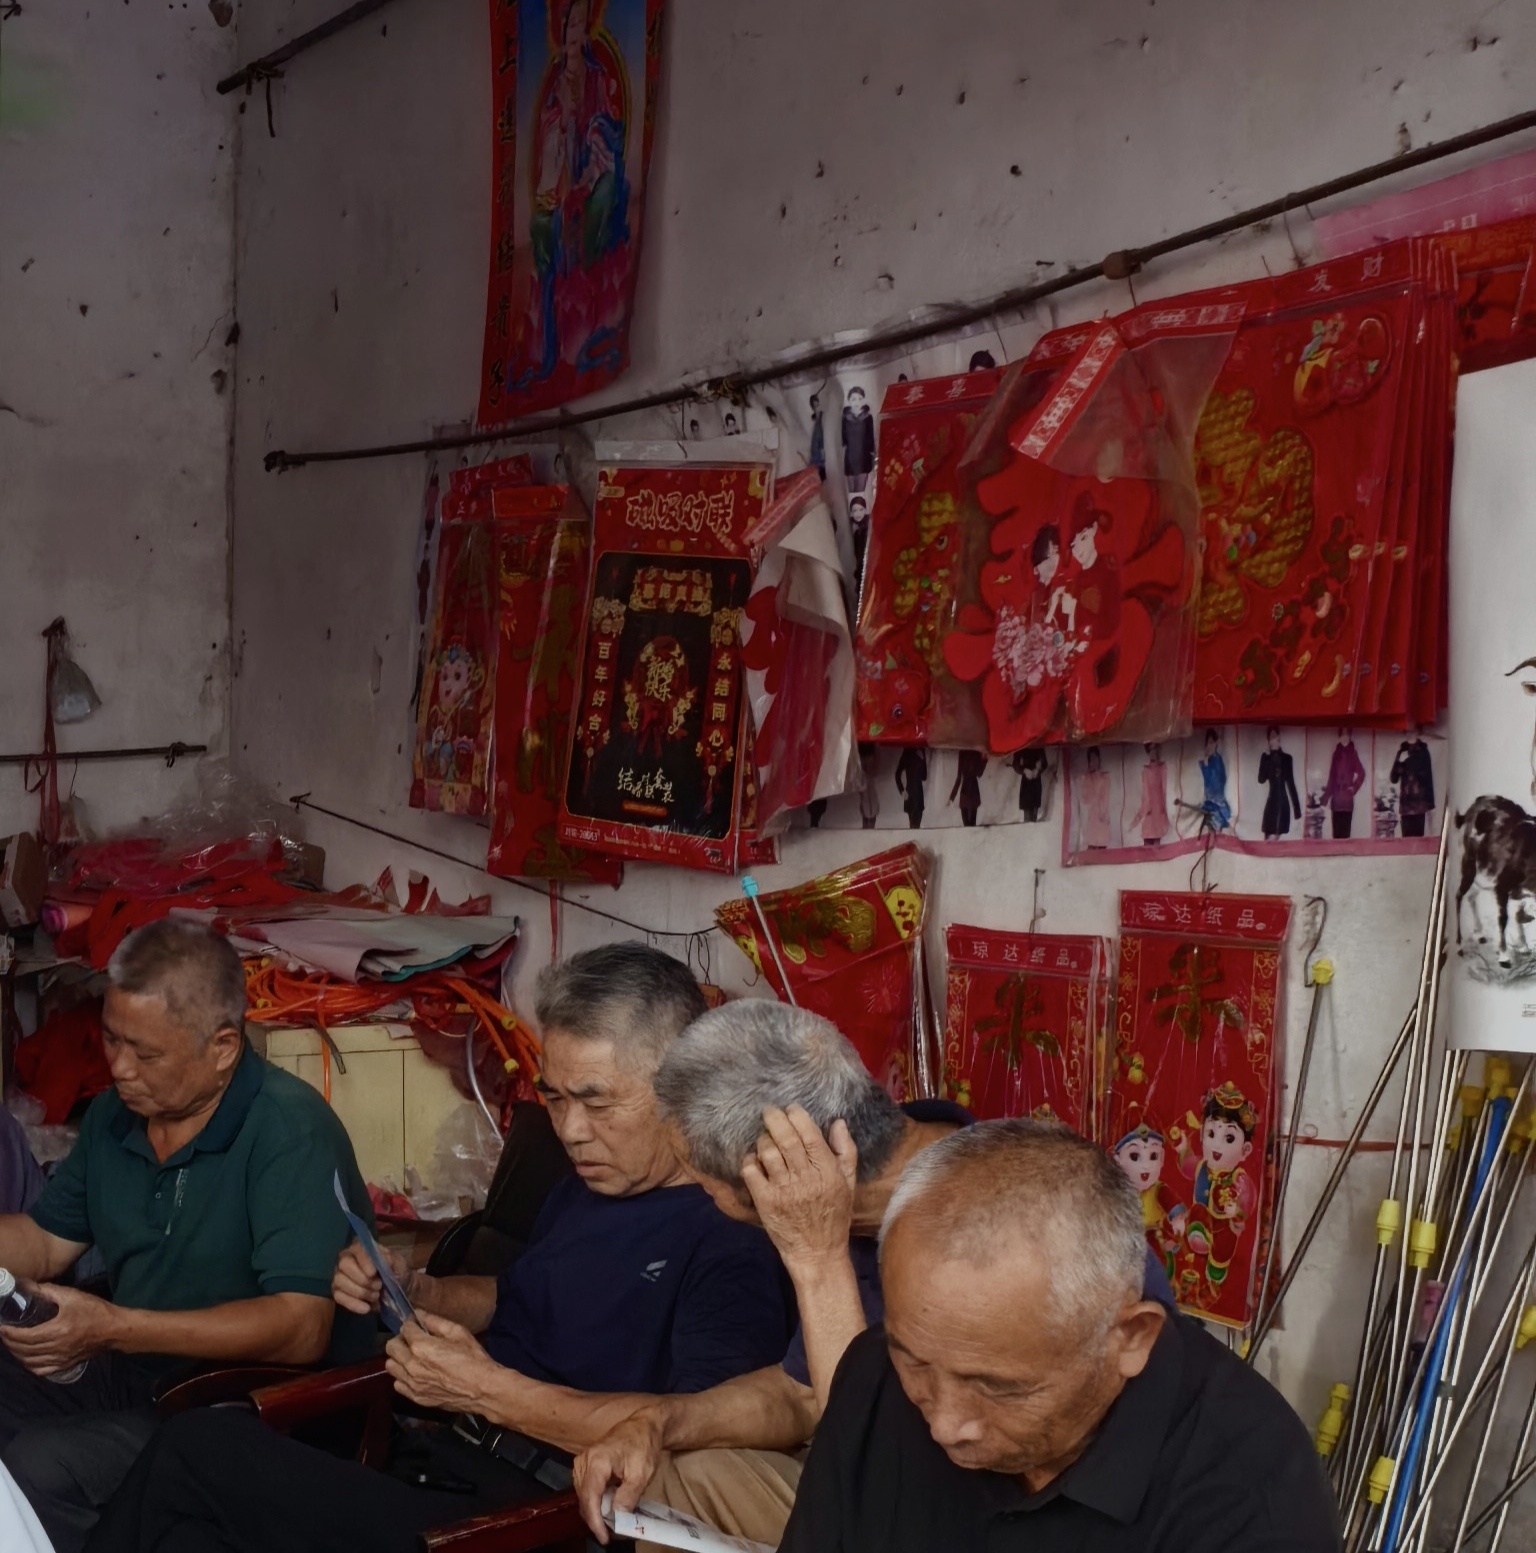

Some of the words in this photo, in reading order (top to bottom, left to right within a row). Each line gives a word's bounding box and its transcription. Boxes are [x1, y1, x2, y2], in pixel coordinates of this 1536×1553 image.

[587, 641, 612, 731] 百年好合
[707, 651, 734, 748] 永结同心
